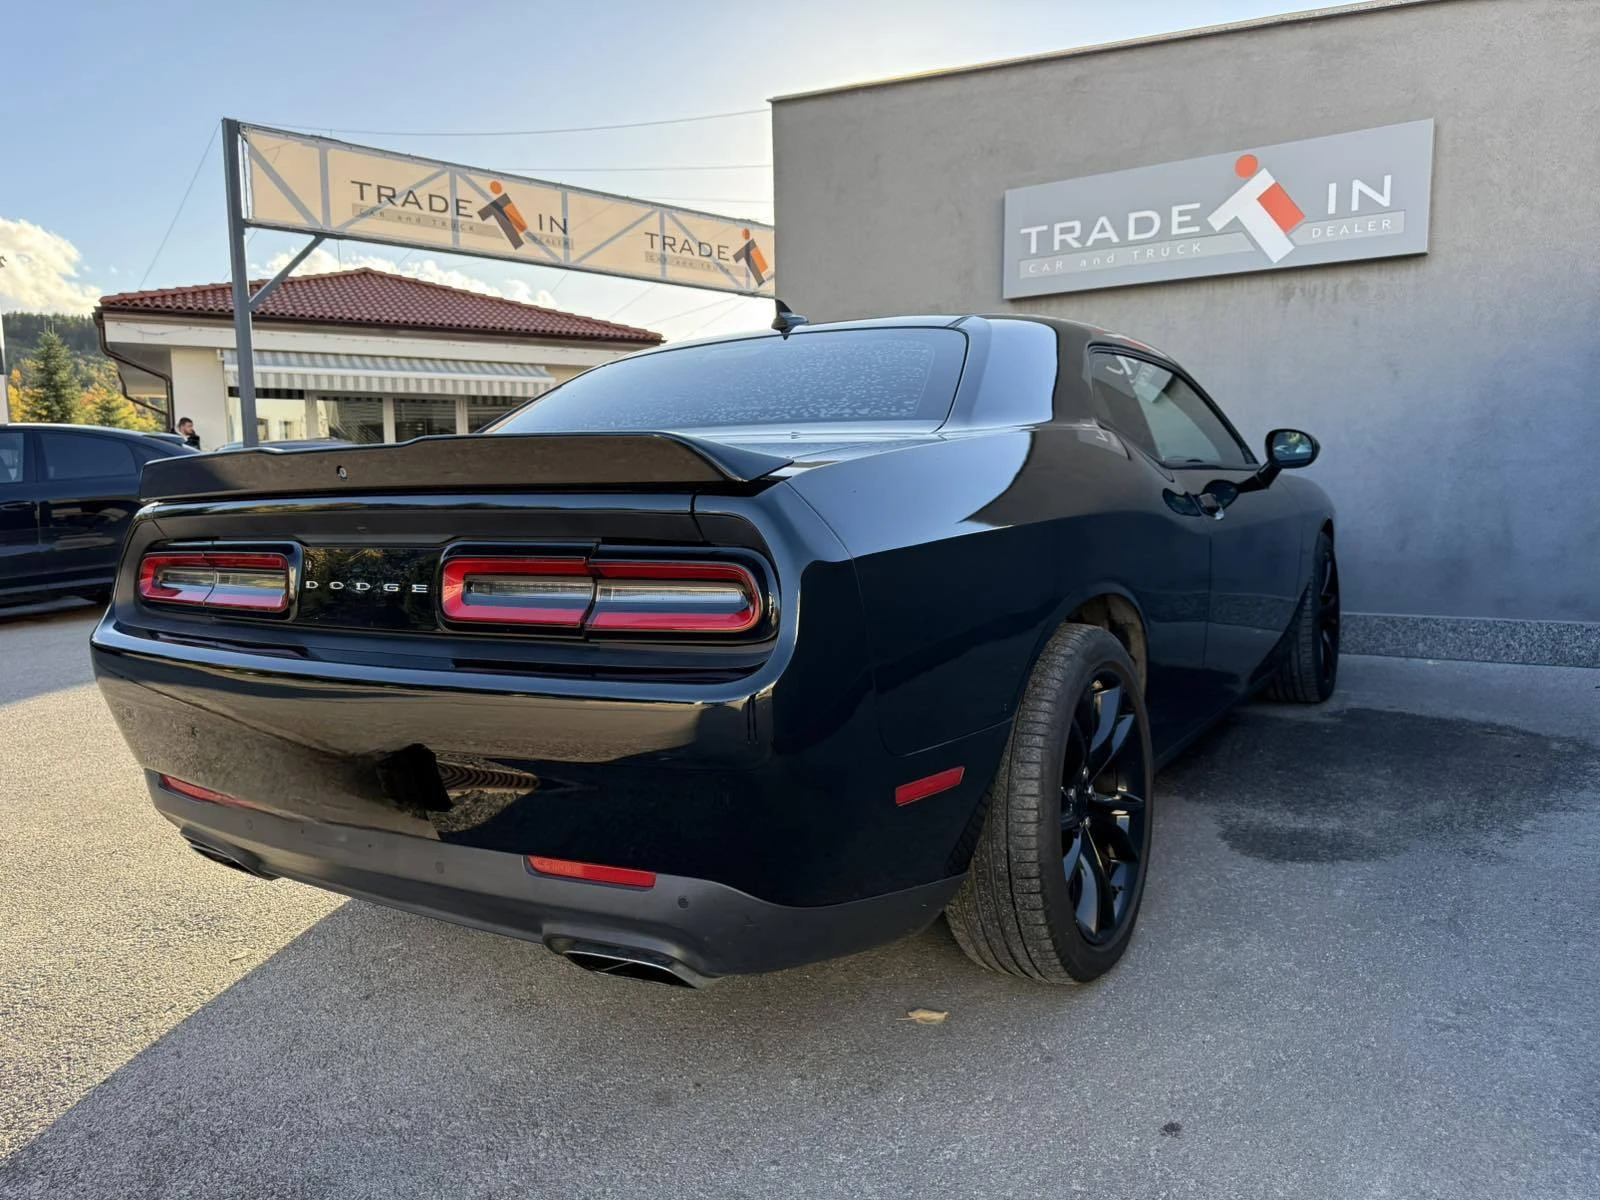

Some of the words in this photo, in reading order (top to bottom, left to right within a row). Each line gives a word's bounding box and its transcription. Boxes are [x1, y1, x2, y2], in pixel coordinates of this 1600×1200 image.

[350, 180, 473, 218] TRADE
[538, 213, 567, 235] IN
[1020, 203, 1200, 254] TRADE
[1327, 174, 1392, 214] IN
[644, 232, 730, 261] TRADE
[1028, 260, 1064, 274] CAR
[1079, 253, 1115, 268] and
[1132, 241, 1201, 260] TRUCK
[1312, 218, 1392, 238] DEALER
[305, 580, 429, 593] DODGE
